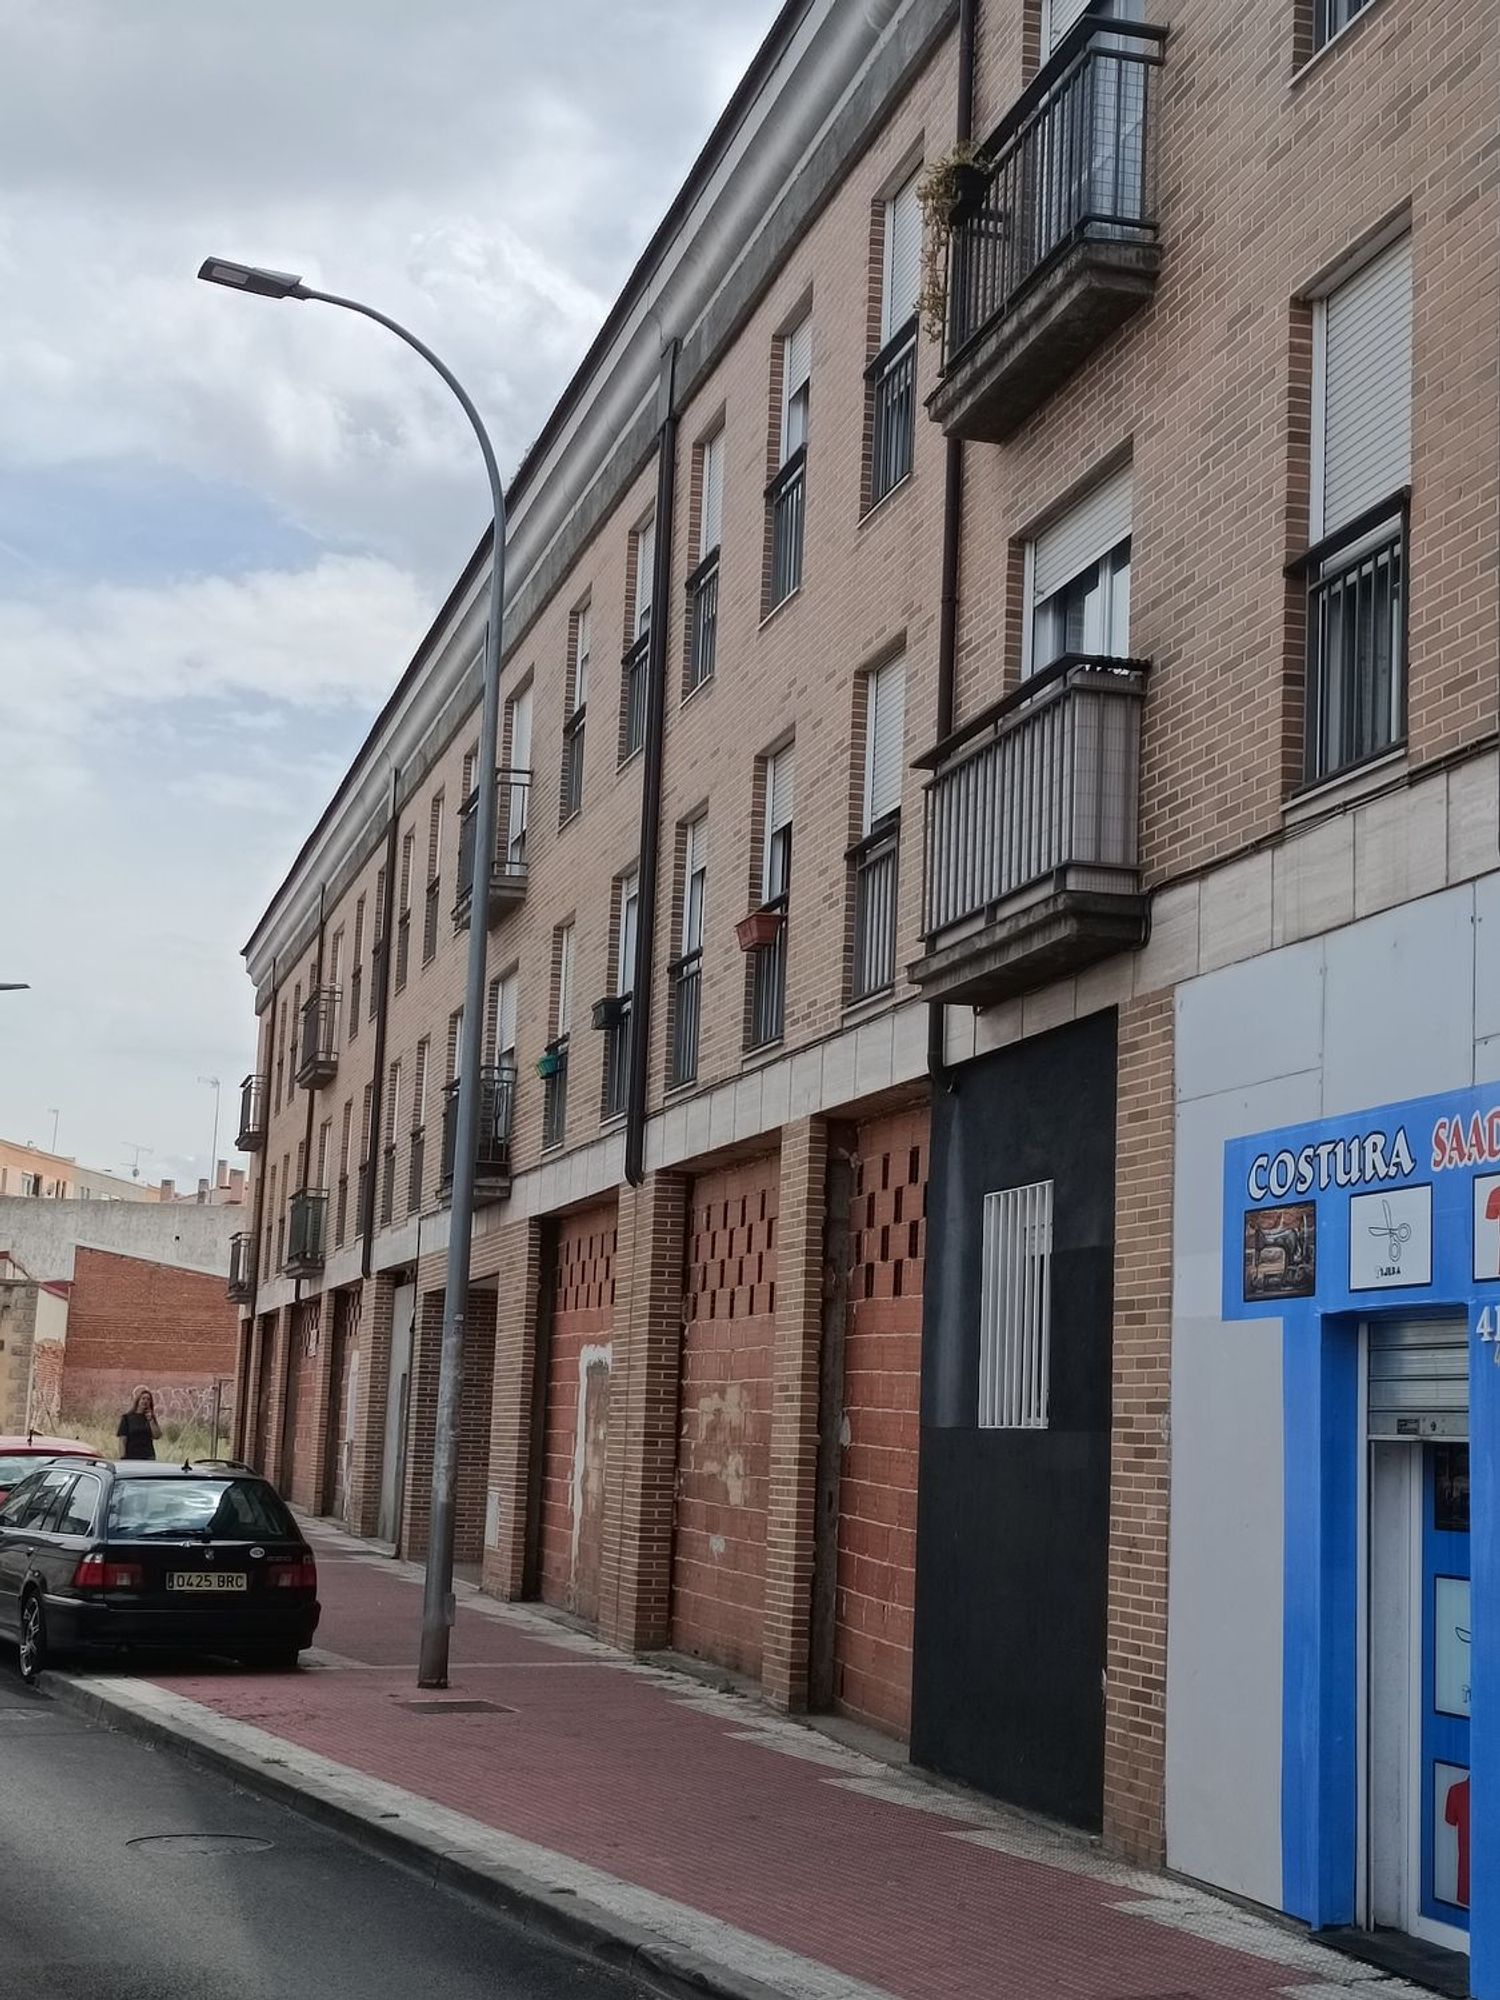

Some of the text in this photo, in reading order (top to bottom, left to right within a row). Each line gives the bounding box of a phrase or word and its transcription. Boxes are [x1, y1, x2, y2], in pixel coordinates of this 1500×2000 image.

[1248, 1127, 1416, 1200] COSTURA
[177, 1574, 243, 1588] 0425 BRC
